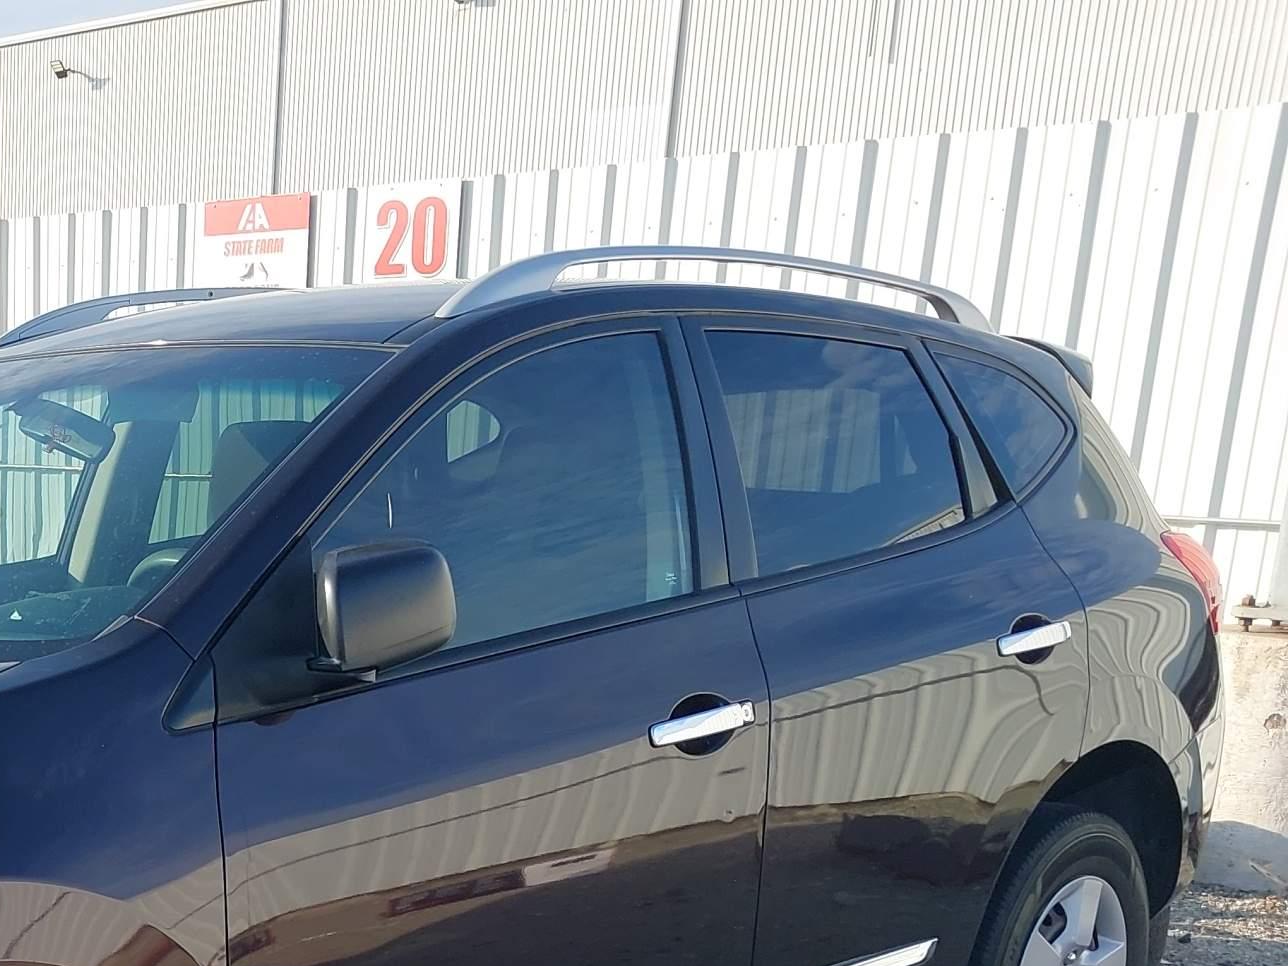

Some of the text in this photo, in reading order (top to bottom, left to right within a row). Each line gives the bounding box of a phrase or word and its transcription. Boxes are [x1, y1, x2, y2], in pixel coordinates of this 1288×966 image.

[224, 237, 284, 257] STATE FARM
[375, 196, 449, 277] 20
